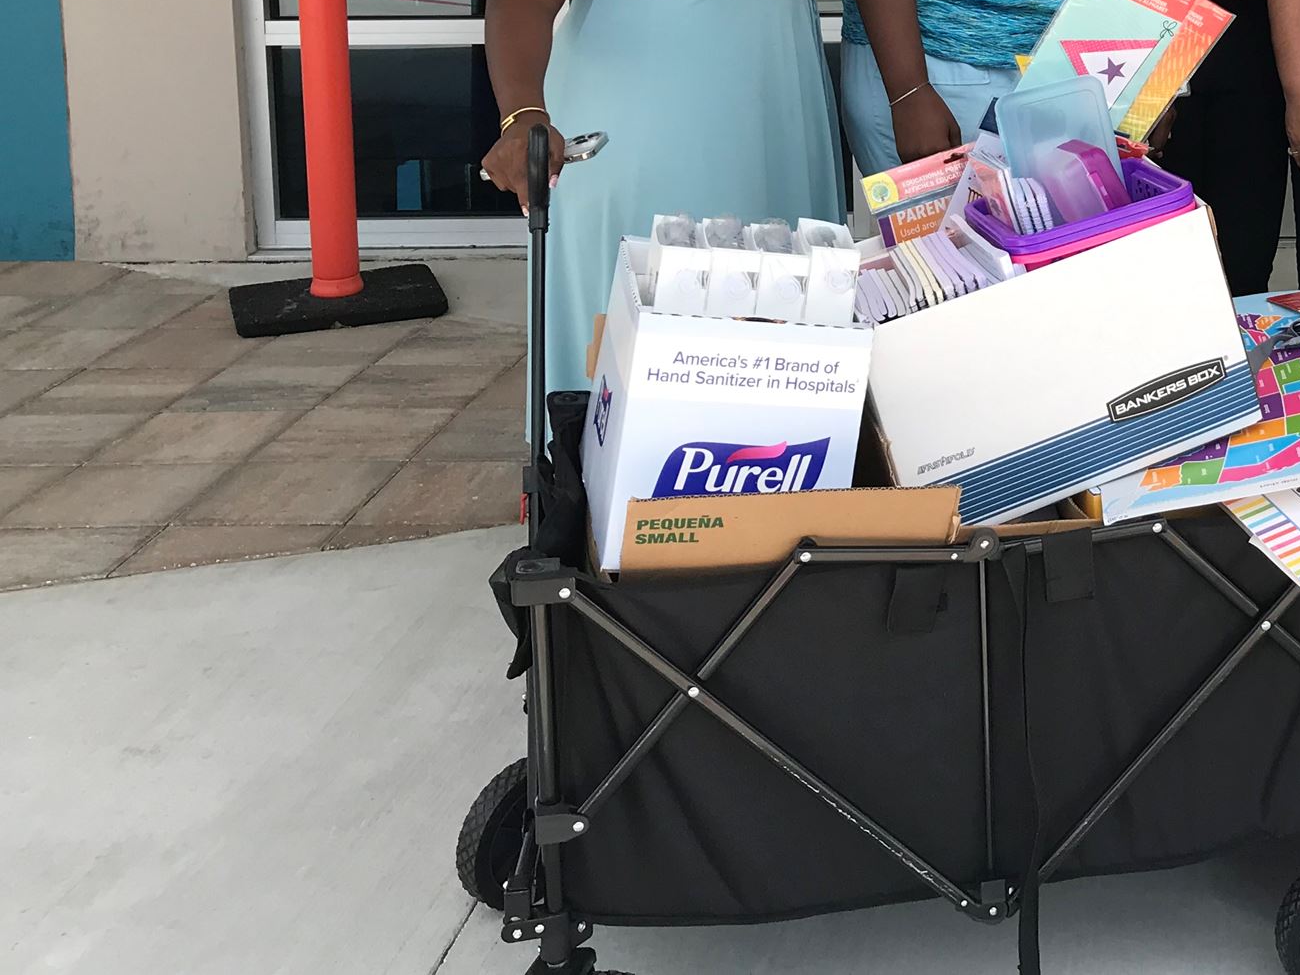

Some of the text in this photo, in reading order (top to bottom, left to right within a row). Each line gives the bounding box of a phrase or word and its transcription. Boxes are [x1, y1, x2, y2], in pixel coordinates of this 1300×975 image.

[900, 226, 920, 238] Used
[672, 351, 840, 375] America's #1 Brand of
[647, 367, 856, 395] Hand Sanitizer in Hospitals
[1115, 365, 1221, 416] BANKERS BOX
[673, 447, 812, 493] Purell
[636, 515, 724, 531] PEQUEÑA
[634, 531, 700, 545] SMALL
